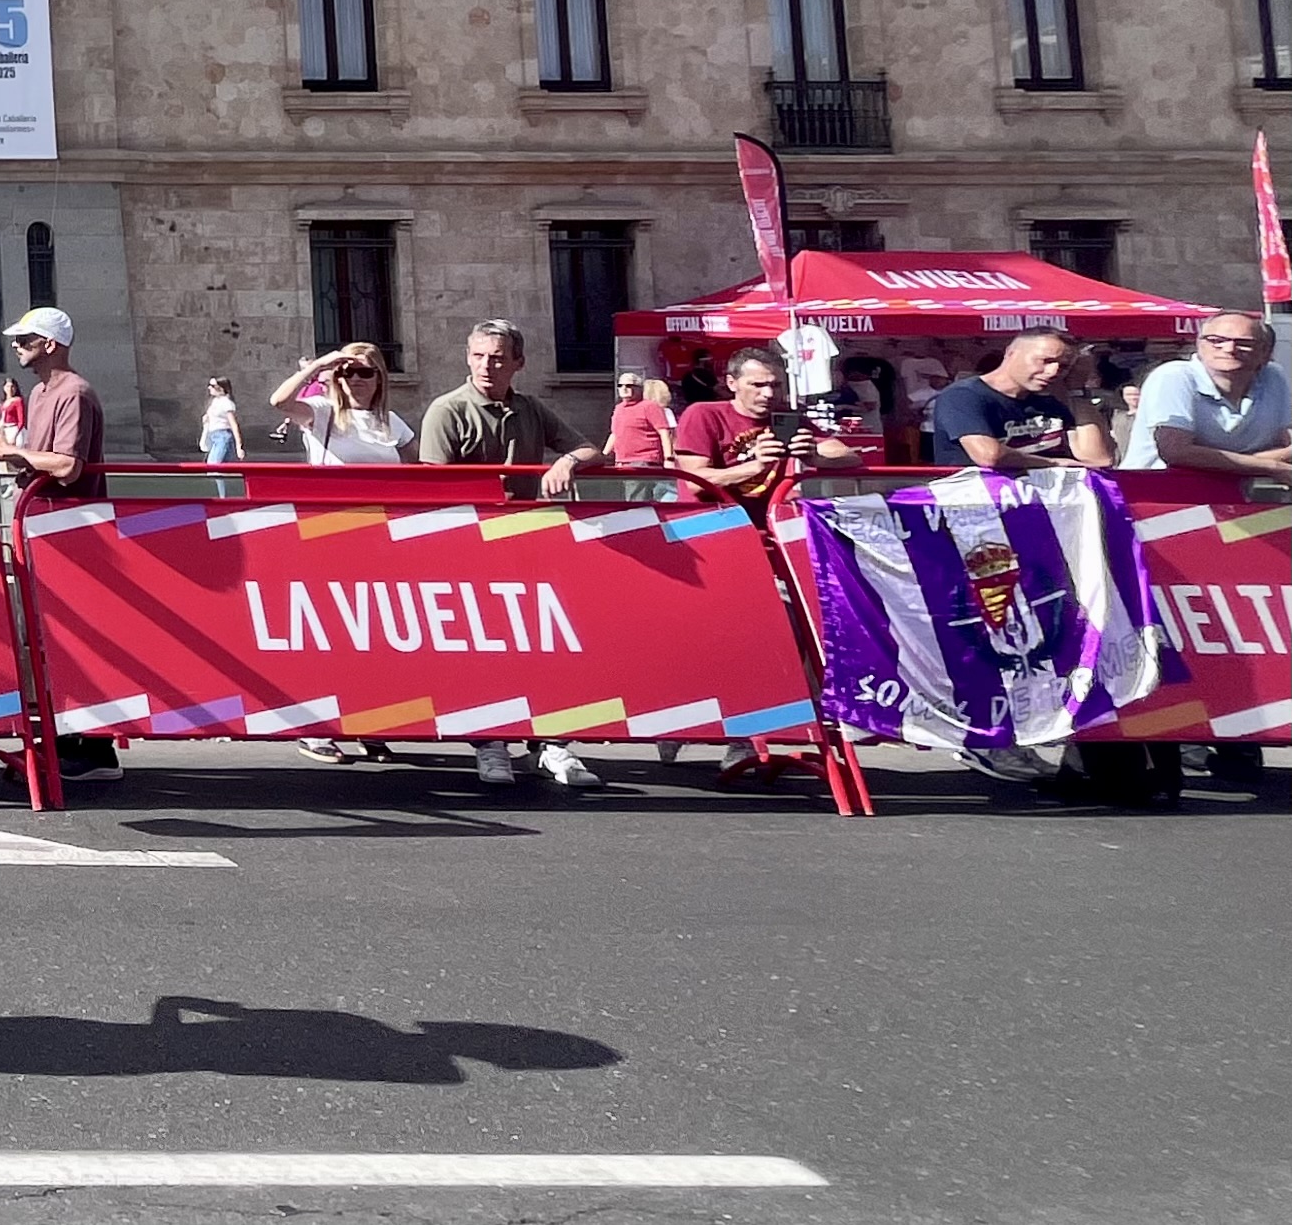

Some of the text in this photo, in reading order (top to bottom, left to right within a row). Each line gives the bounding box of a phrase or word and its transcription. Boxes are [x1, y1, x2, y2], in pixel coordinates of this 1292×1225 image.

[819, 315, 875, 333] VUELTA
[244, 580, 584, 654] LA VUELTA
